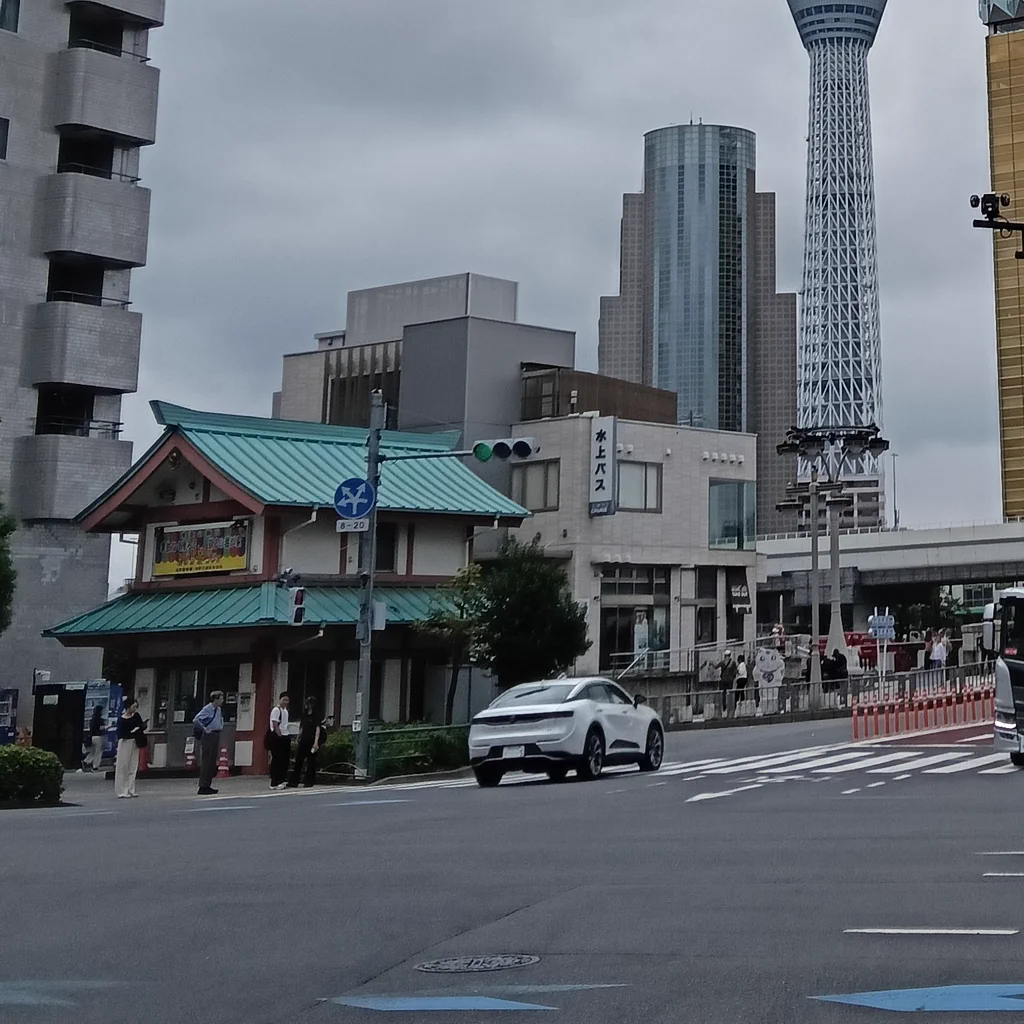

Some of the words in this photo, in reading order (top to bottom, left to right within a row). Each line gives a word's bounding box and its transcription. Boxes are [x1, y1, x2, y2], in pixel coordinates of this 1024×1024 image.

[594, 428, 607, 492] 水上バス
[340, 521, 365, 530] 8-20
